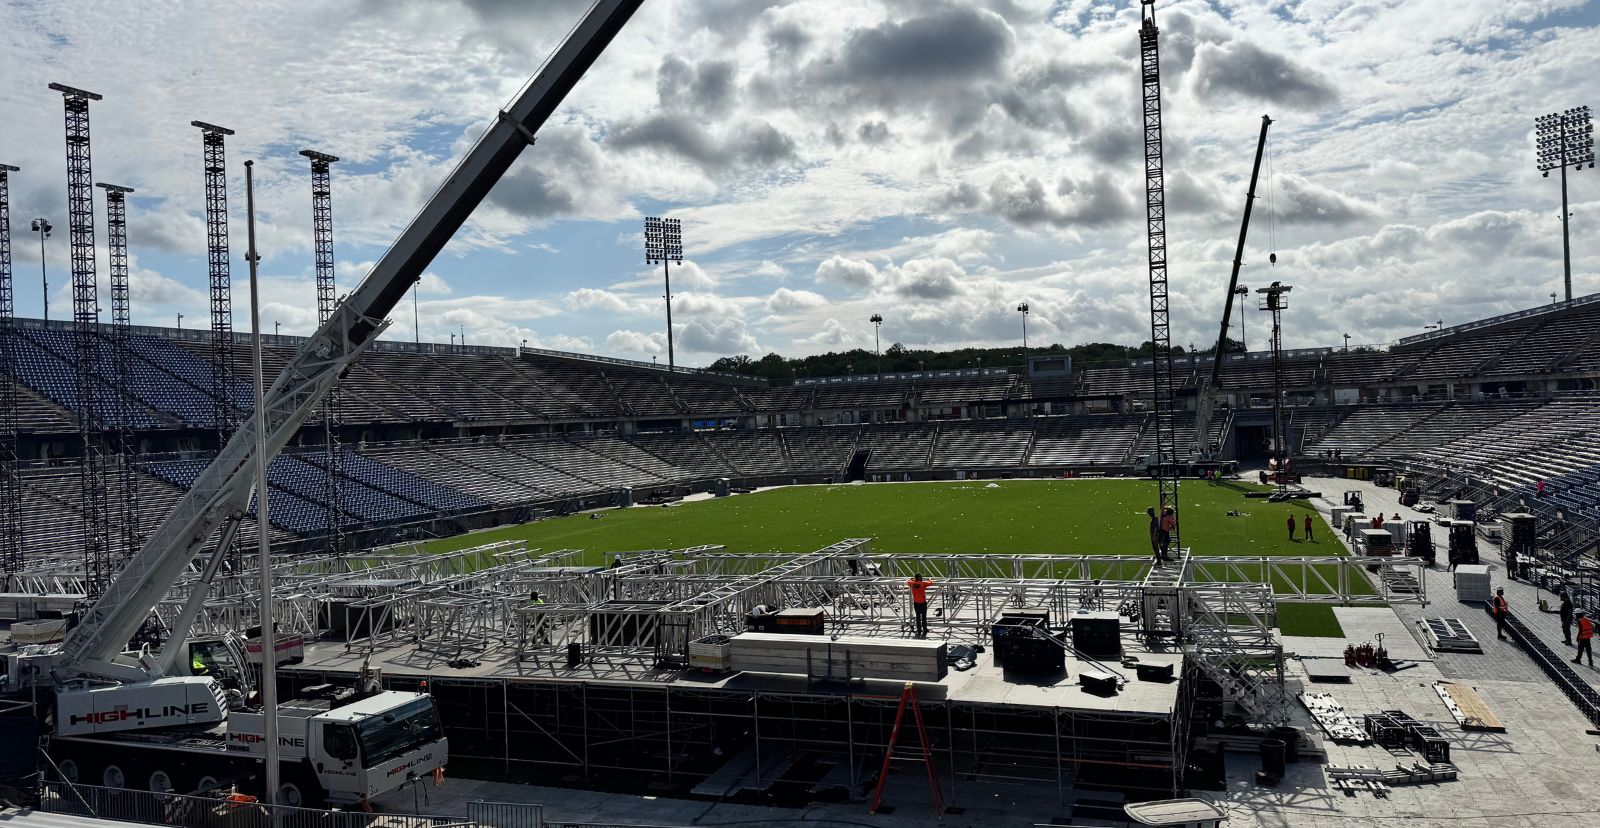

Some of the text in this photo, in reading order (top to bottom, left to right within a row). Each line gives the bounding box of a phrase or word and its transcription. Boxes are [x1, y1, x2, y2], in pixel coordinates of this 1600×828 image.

[70, 703, 208, 725] HIGHLINE
[229, 733, 304, 747] HIGHINE
[386, 753, 432, 777] HIGHLINE
